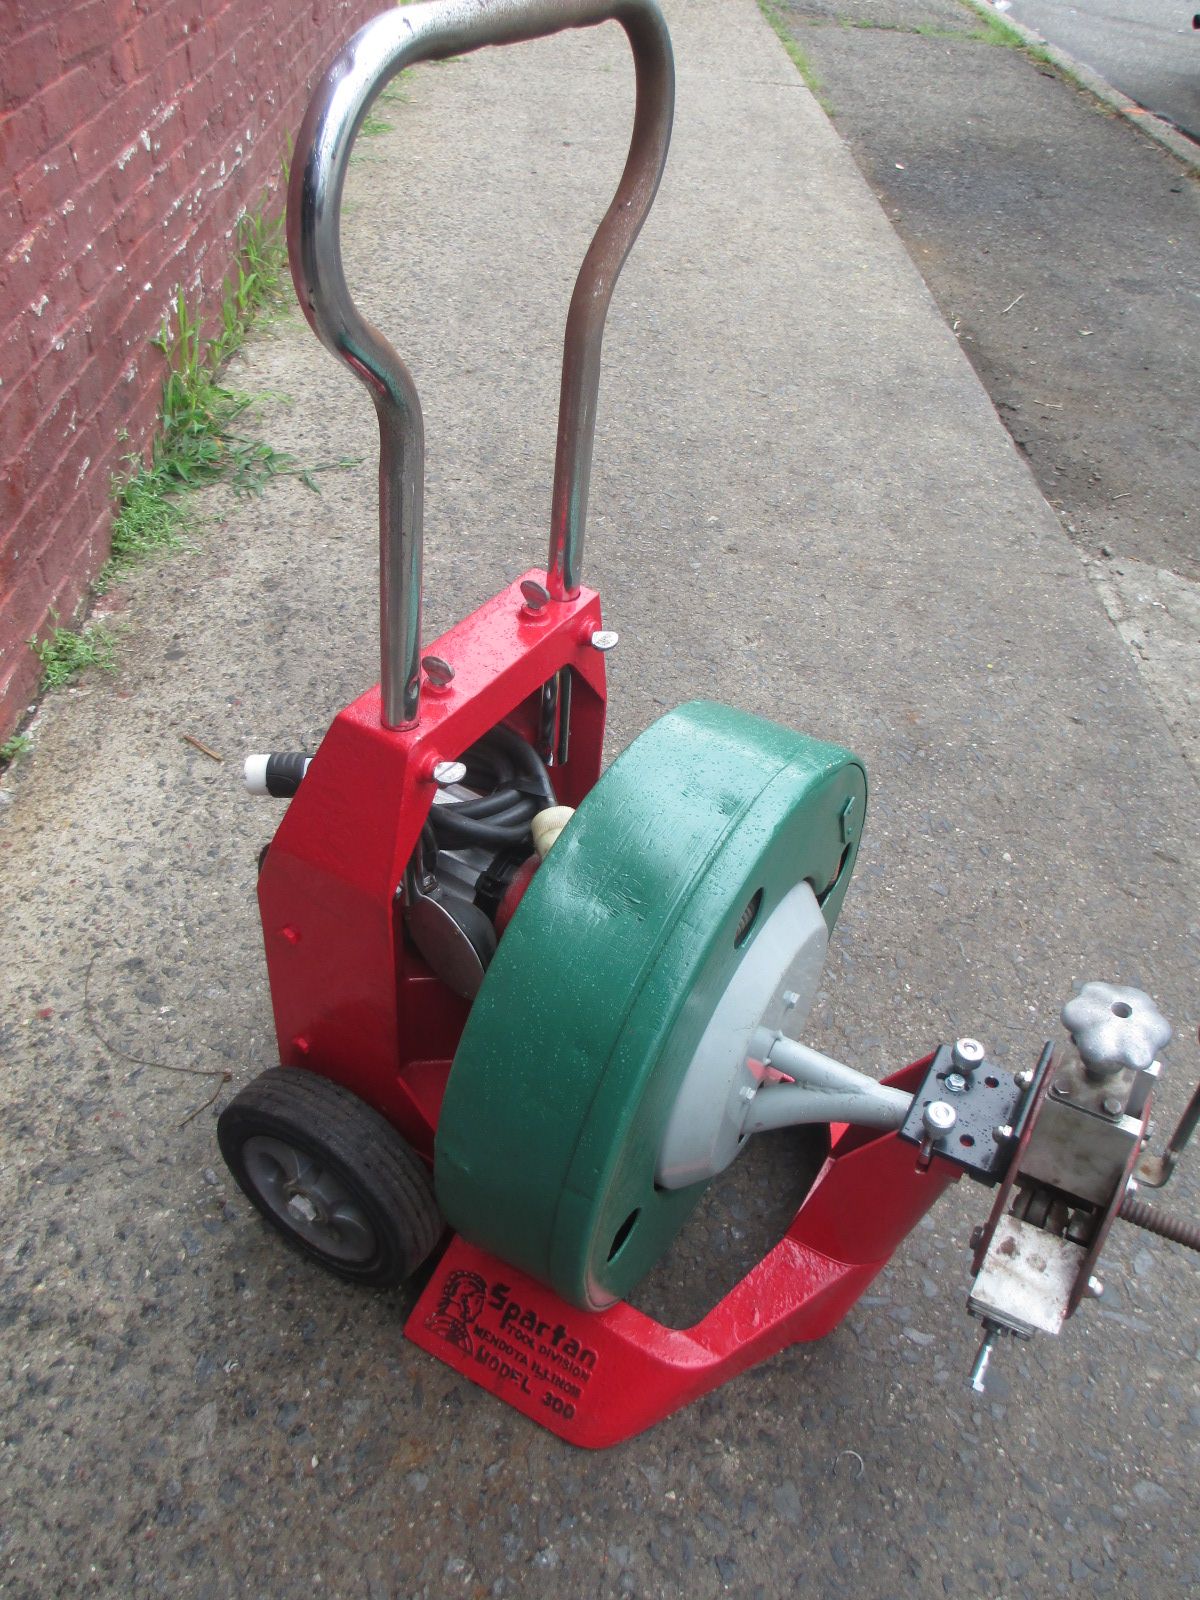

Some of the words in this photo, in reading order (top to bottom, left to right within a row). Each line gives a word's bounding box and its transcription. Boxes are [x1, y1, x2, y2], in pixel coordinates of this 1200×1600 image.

[474, 1324, 528, 1366] MENDOTA
[488, 1282, 598, 1369] Spartan
[507, 1323, 535, 1350] TOOL
[539, 1345, 592, 1383] DIVISION
[476, 1344, 531, 1395] MODEL
[543, 1391, 575, 1420] 300
